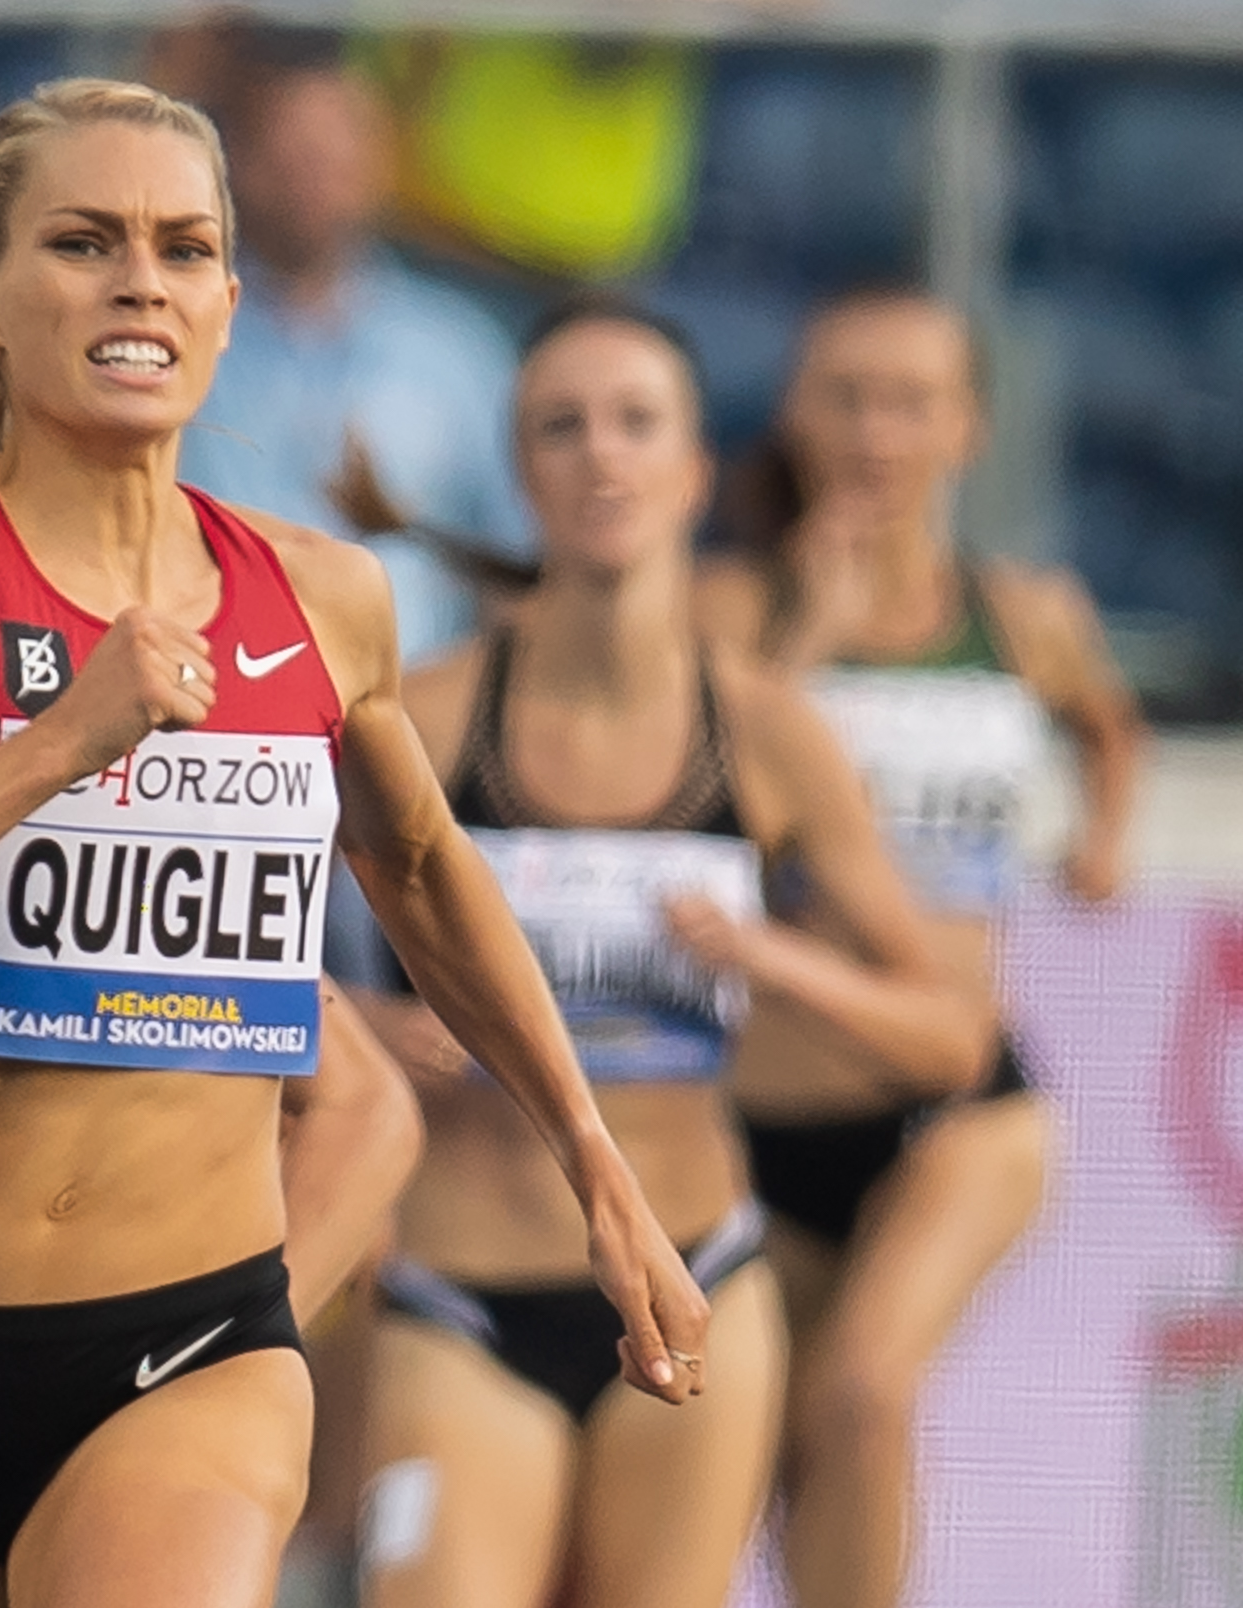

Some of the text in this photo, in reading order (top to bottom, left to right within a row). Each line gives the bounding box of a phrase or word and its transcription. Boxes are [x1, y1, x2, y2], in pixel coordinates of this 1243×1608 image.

[7, 837, 321, 962] QUIGLEY
[97, 991, 243, 1024] MEMORIAŁ
[107, 1018, 308, 1054] SKOLIMOWSKIEJ
